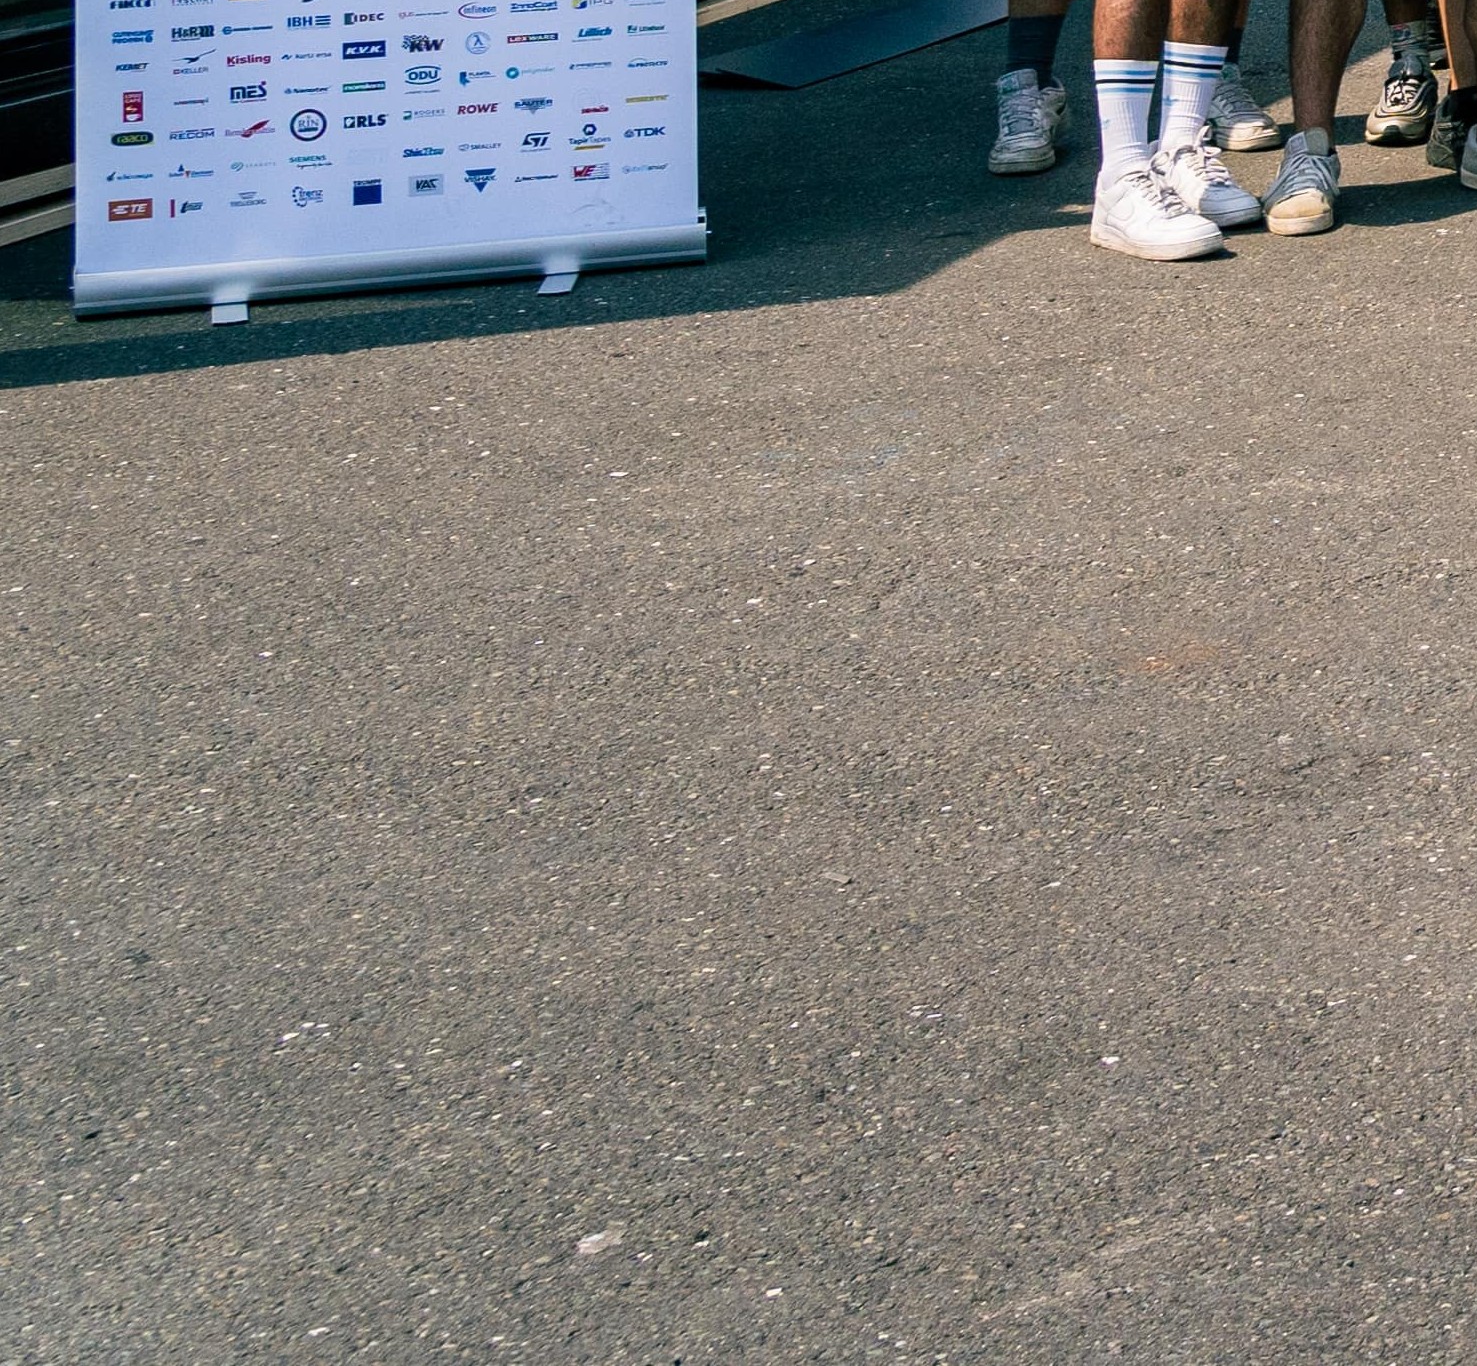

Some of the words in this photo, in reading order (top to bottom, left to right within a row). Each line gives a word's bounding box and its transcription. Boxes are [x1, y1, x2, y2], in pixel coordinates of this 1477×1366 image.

[287, 16, 313, 28] IBH
[354, 12, 385, 22] IDEC
[226, 54, 271, 67] Kisling
[408, 69, 438, 81] ODU
[457, 103, 499, 115] ROWE
[355, 115, 386, 127] RLS
[634, 126, 666, 138] TDK
[130, 204, 147, 214] TE
